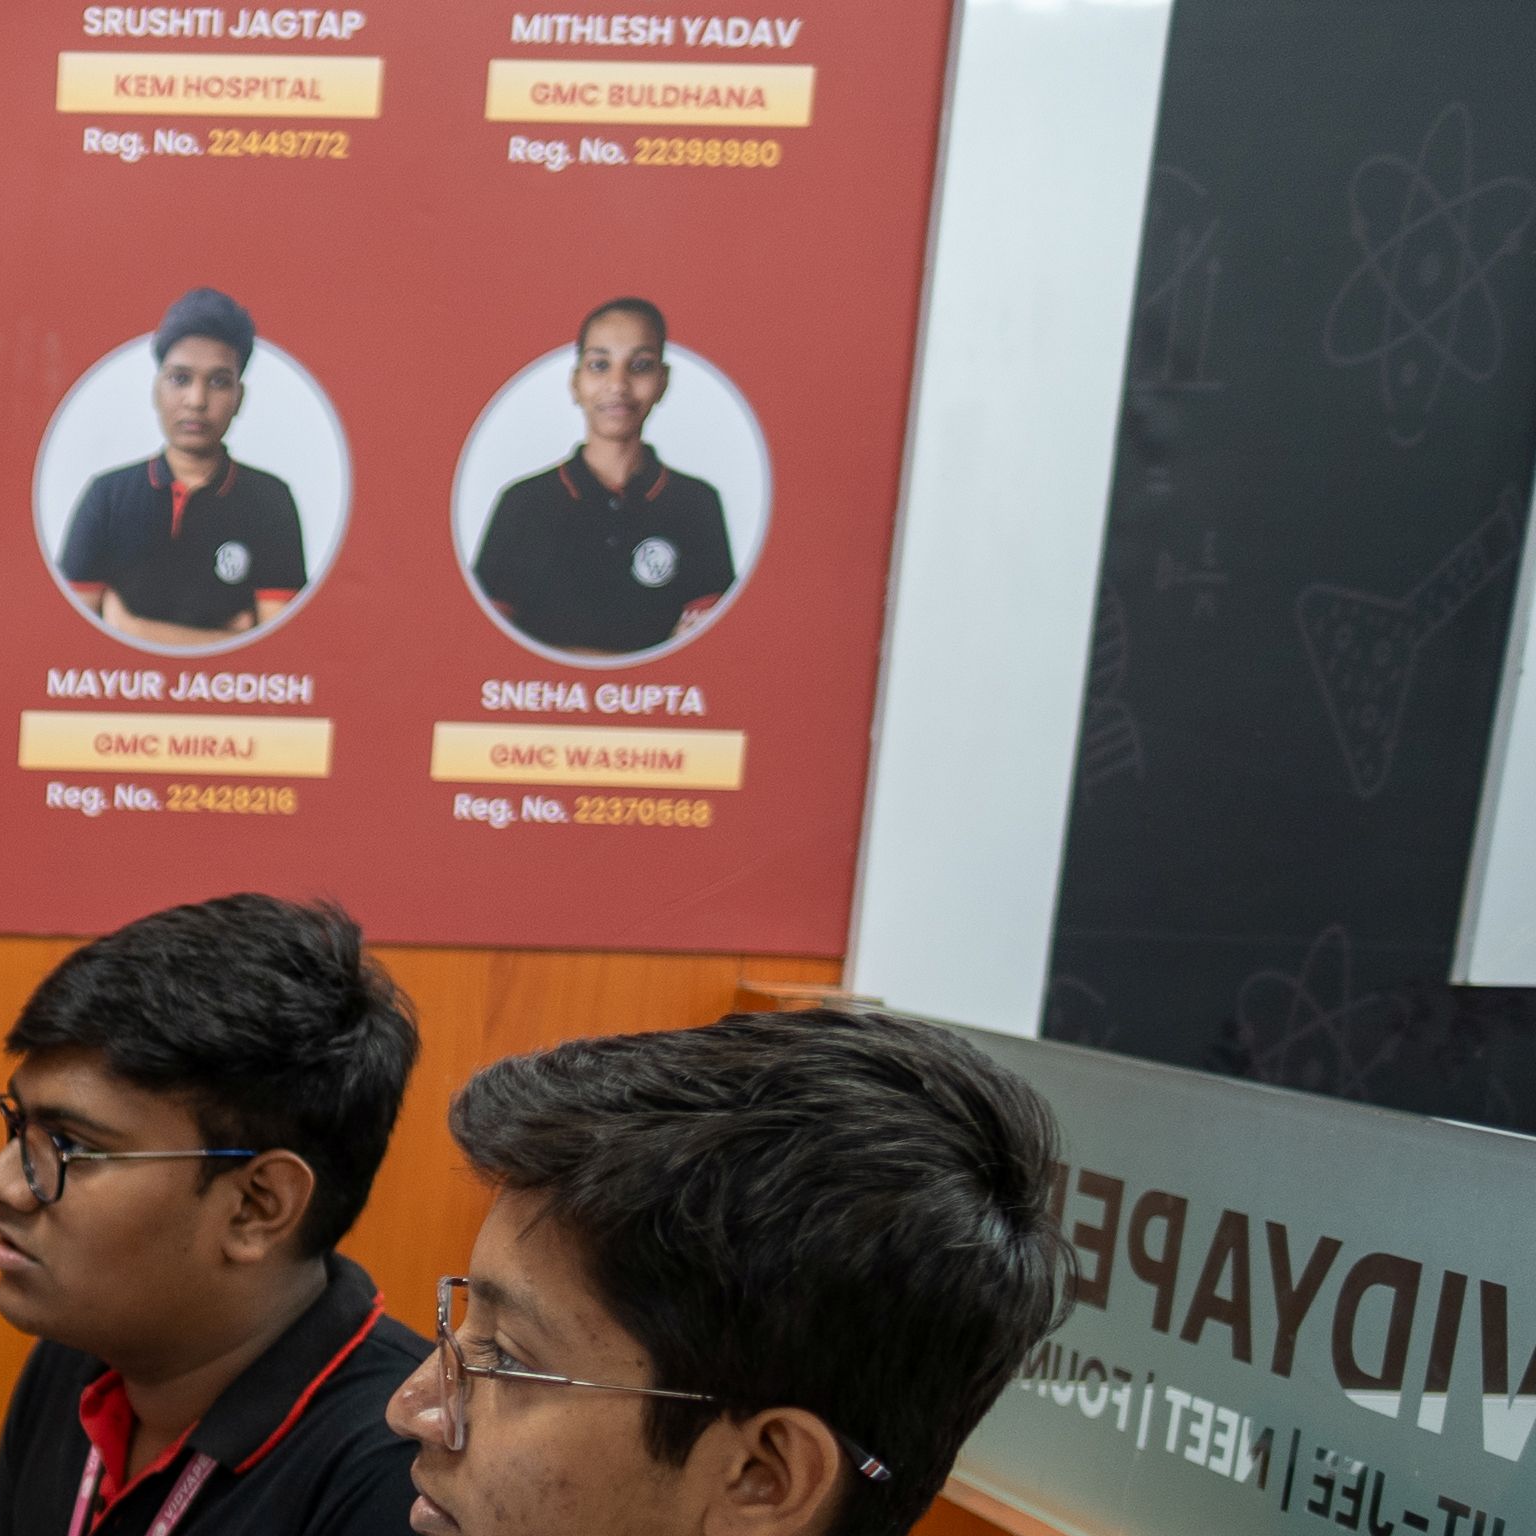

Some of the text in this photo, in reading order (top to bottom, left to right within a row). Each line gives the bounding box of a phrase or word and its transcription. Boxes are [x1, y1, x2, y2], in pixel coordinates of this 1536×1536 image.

[83, 6, 366, 40] SRUSHTI JAGTAP
[511, 13, 802, 48] MITHLESH YADAV
[114, 74, 324, 103] KEM HOSPITAL
[530, 82, 768, 110] GMC BULDHANA
[83, 126, 347, 163] Reg. No. 22449772
[507, 135, 575, 172] Reg.
[578, 137, 629, 165] No.
[46, 668, 313, 704] MAYUR JAGDISH
[481, 679, 705, 715] SNEHA GUPTA
[93, 733, 255, 760] GMC MIRAJ
[490, 745, 686, 773] GMC WASHIM
[46, 781, 109, 817] Reg.
[113, 784, 161, 811] No.
[453, 793, 517, 829] Reg.
[520, 795, 569, 823] No.
